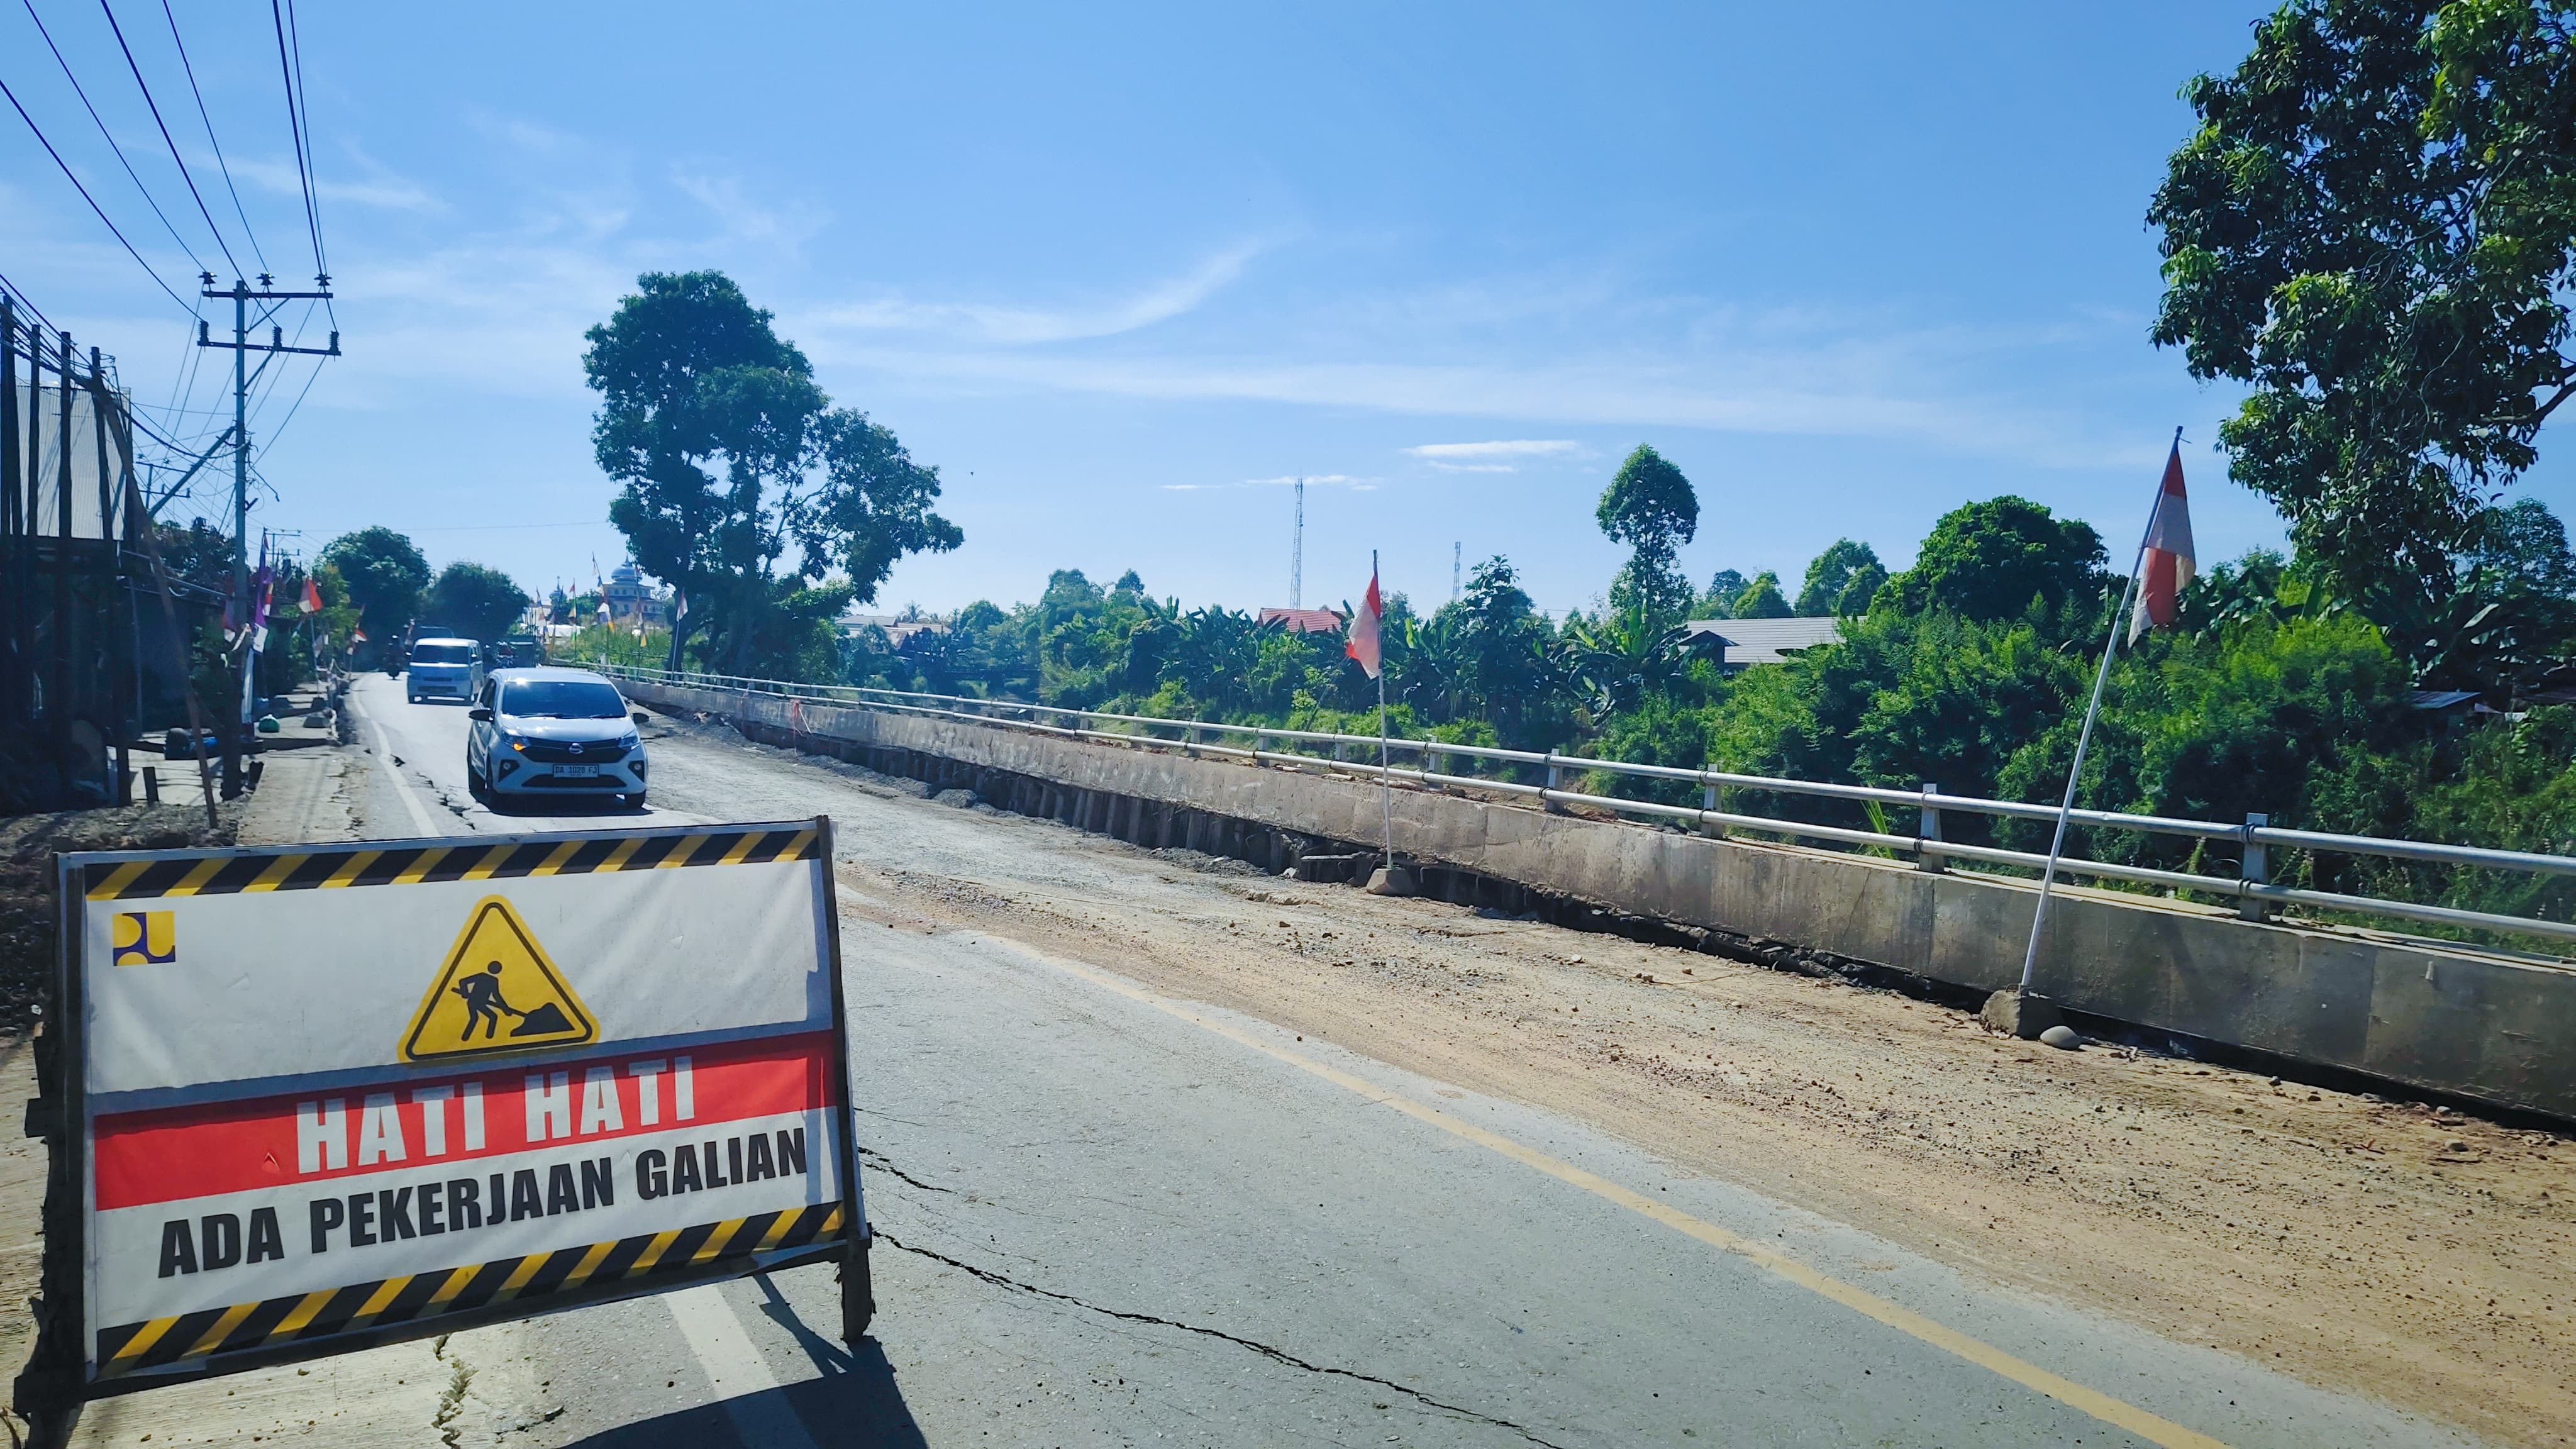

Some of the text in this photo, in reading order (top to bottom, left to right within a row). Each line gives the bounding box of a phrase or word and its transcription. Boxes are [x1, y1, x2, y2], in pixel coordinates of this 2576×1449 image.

[296, 1055, 695, 1174] HATI HATI
[158, 1128, 809, 1278] ADA PEKERJAAN GALIAN
